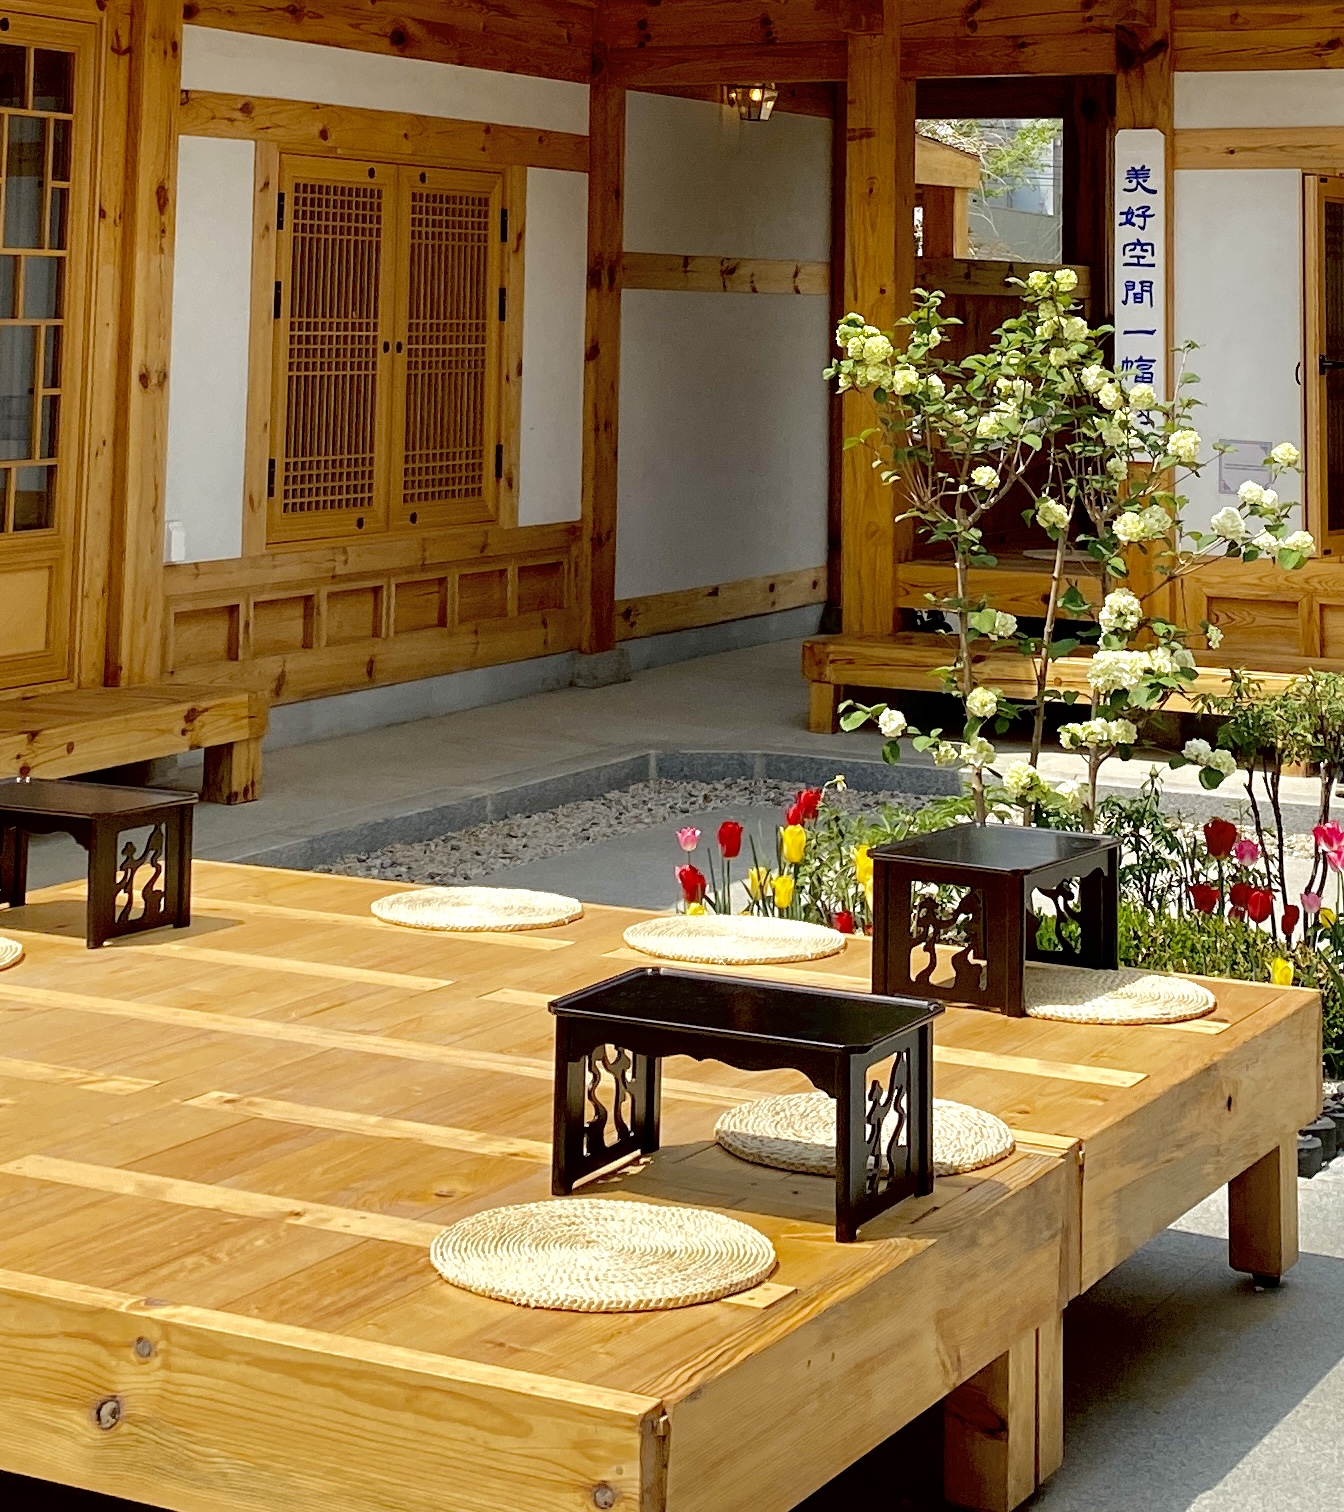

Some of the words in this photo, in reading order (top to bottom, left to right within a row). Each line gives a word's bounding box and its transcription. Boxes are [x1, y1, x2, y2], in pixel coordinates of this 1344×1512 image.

[1118, 164, 1158, 429] 美好空間一幅
